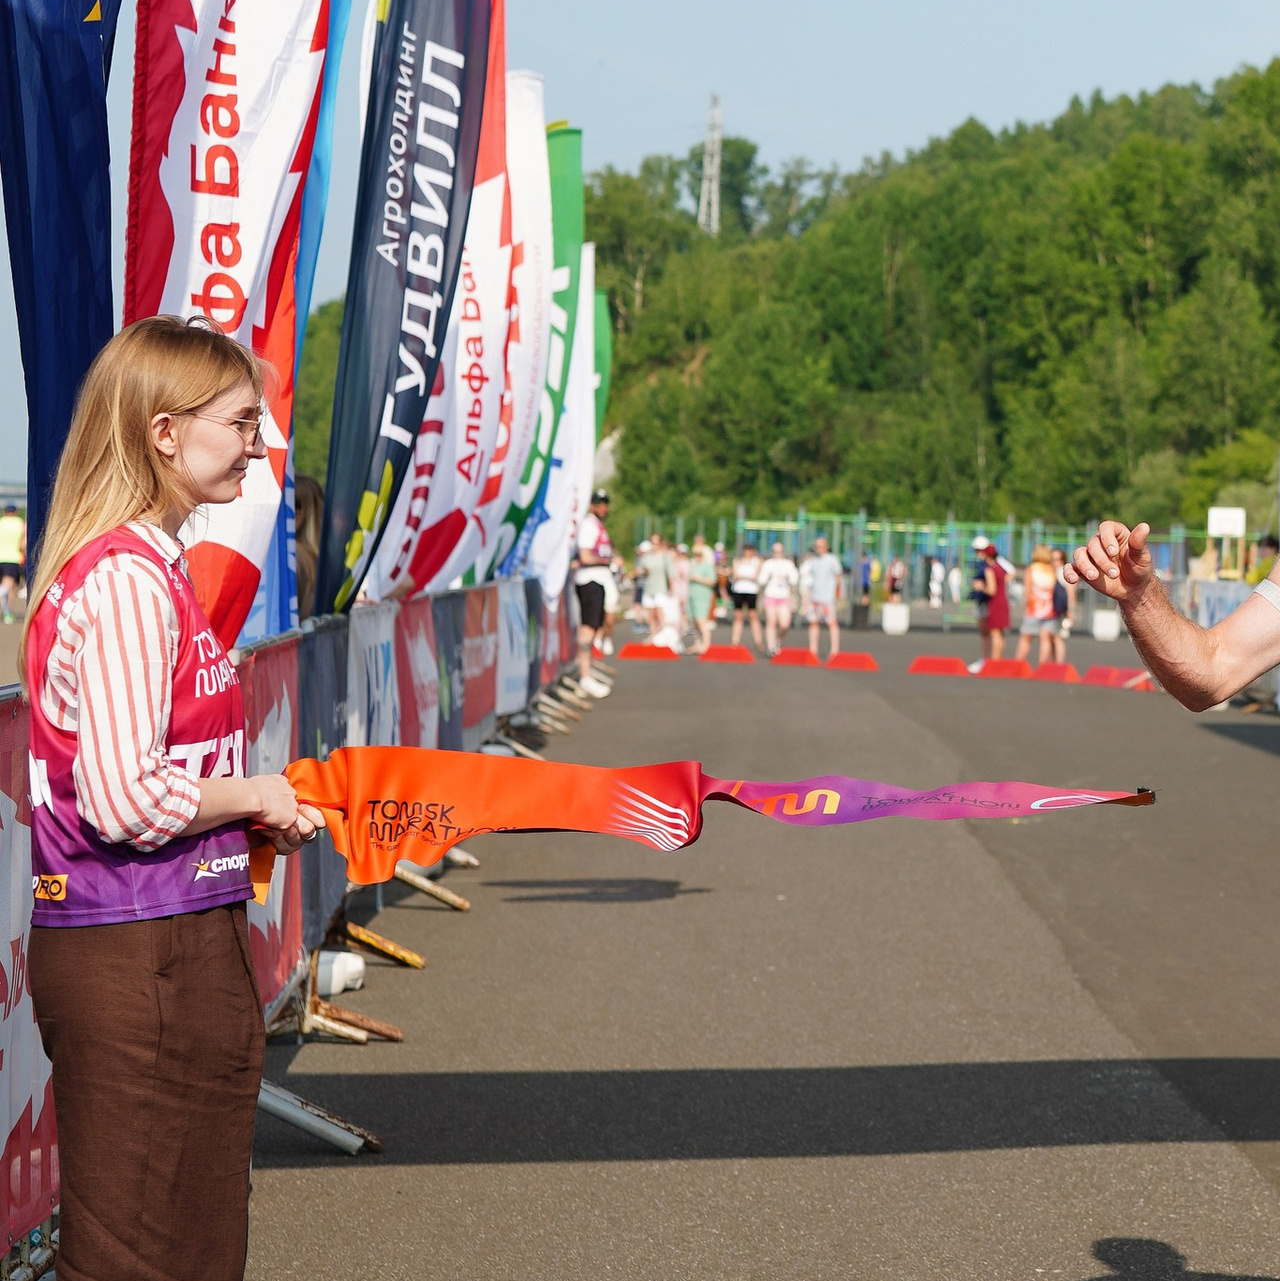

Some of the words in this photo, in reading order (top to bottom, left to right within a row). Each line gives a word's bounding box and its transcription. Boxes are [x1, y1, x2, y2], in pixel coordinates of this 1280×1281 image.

[376, 21, 417, 267] Агрохолдинг
[457, 336, 489, 485] Альфа
[368, 800, 455, 824] TOMSK
